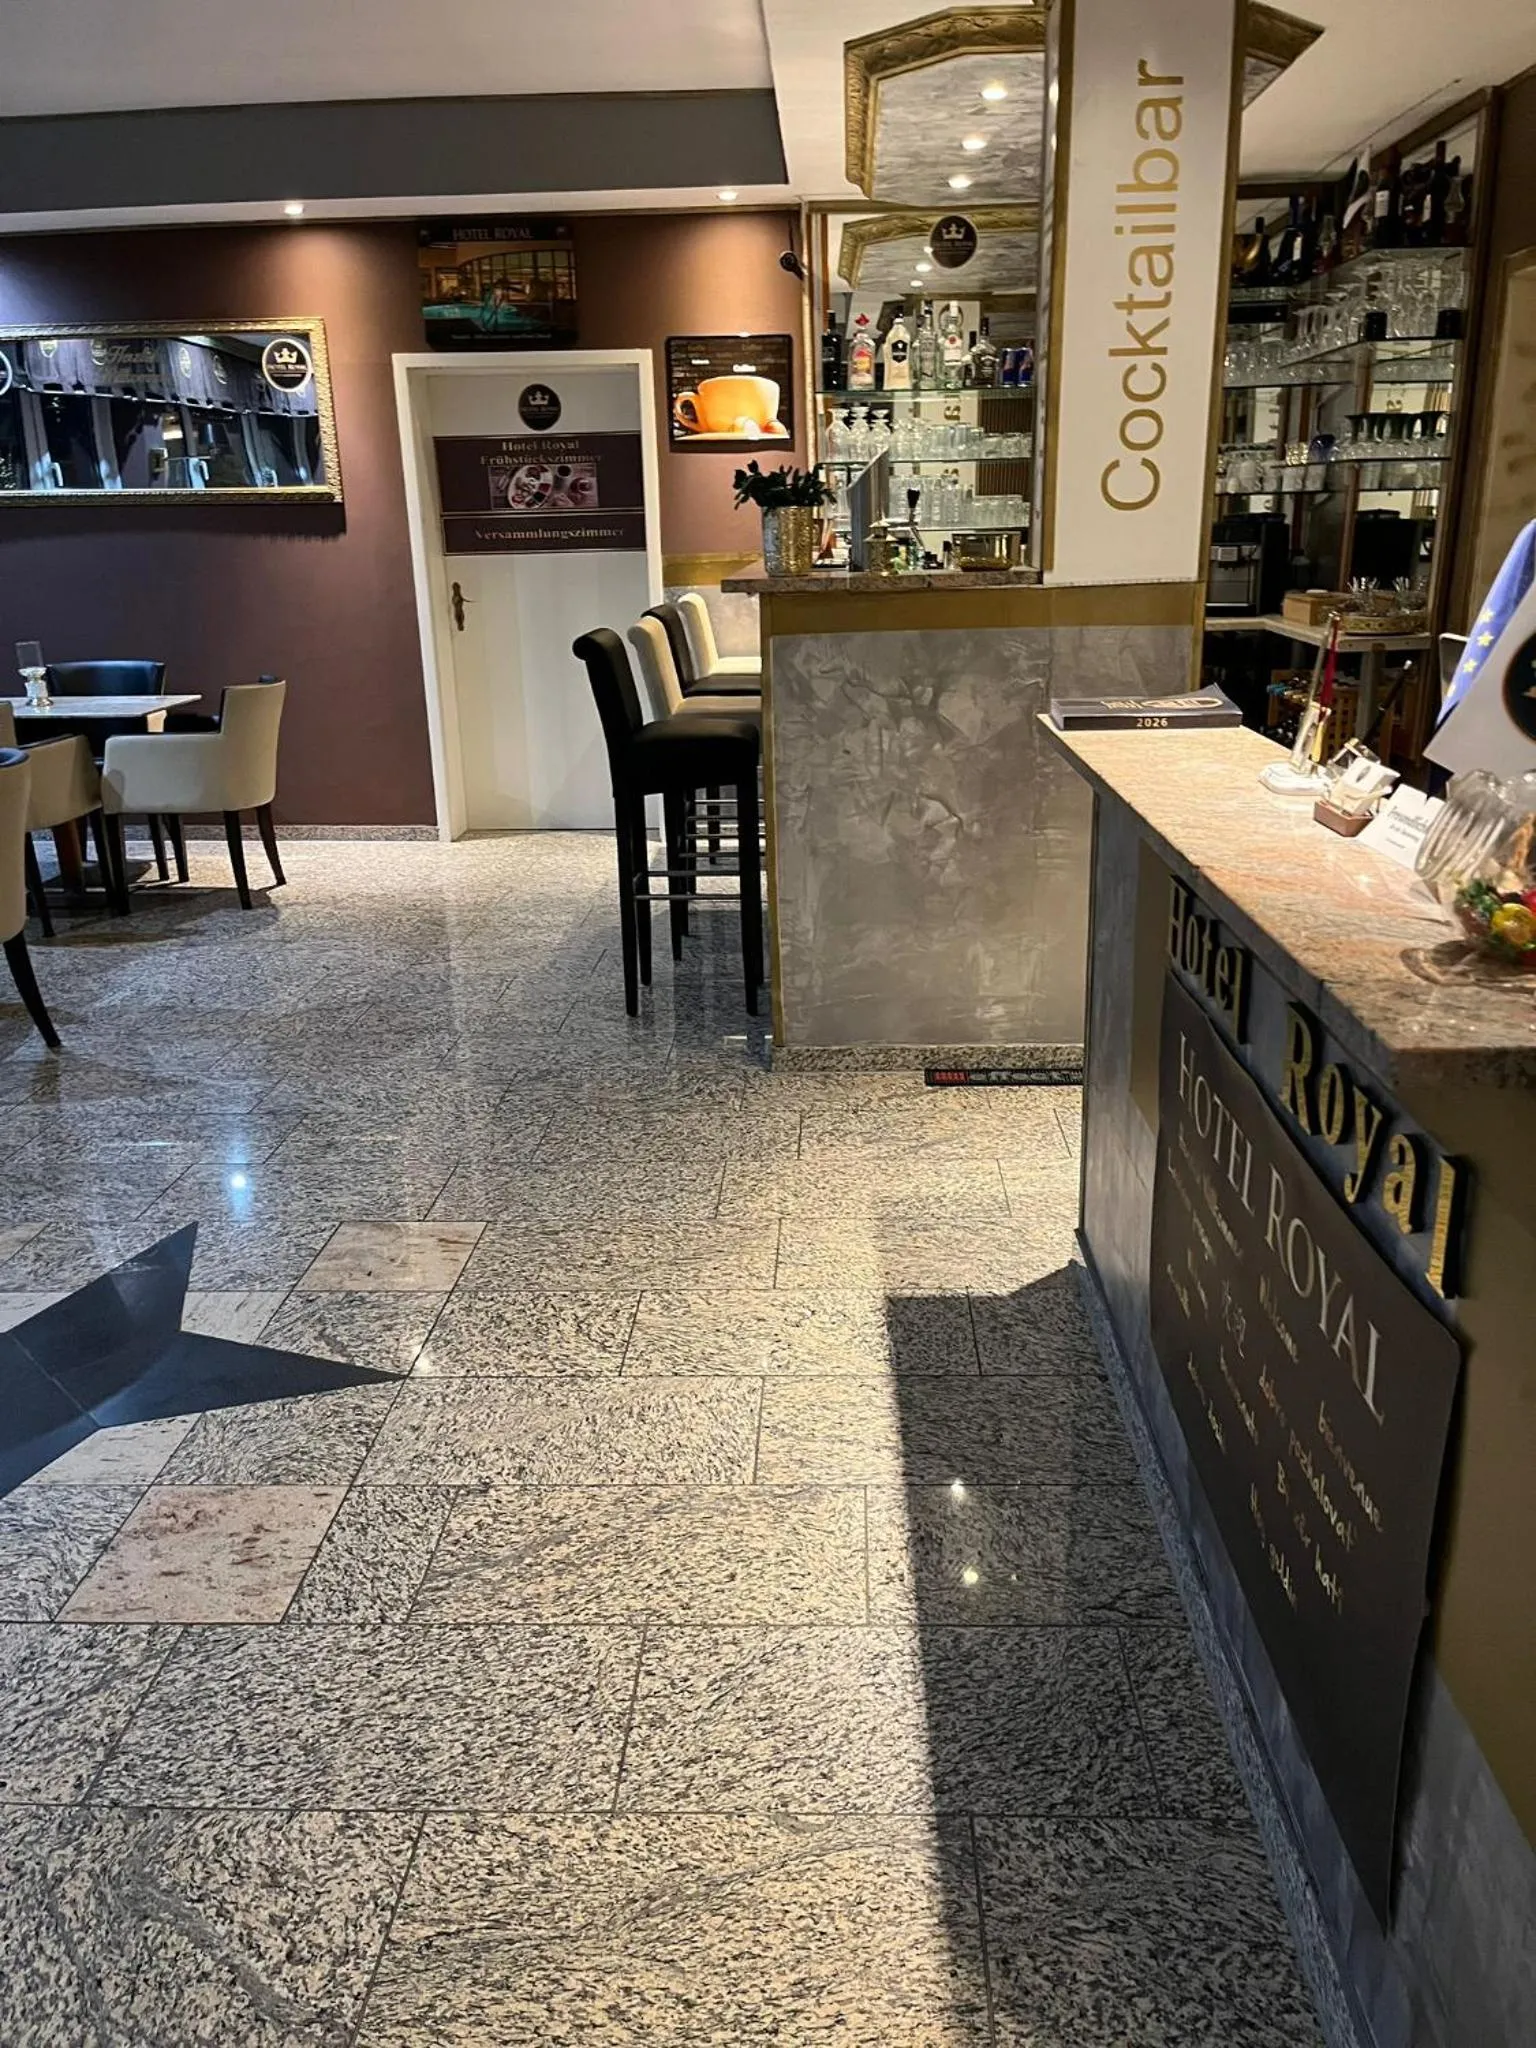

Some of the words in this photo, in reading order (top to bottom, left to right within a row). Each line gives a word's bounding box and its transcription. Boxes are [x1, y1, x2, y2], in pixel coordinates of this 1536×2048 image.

[453, 228, 492, 241] HOTEL
[495, 226, 535, 240] ROYAL
[1100, 58, 1185, 512] Cocktailbar
[502, 440, 537, 452] Hotel
[541, 439, 580, 451] Royal
[1136, 717, 1169, 728] 2026
[1167, 874, 1247, 1045] Hotel
[1280, 1001, 1460, 1300] Royal
[1177, 1031, 1256, 1218] HOTEL
[1264, 1163, 1385, 1427] ROYAL
